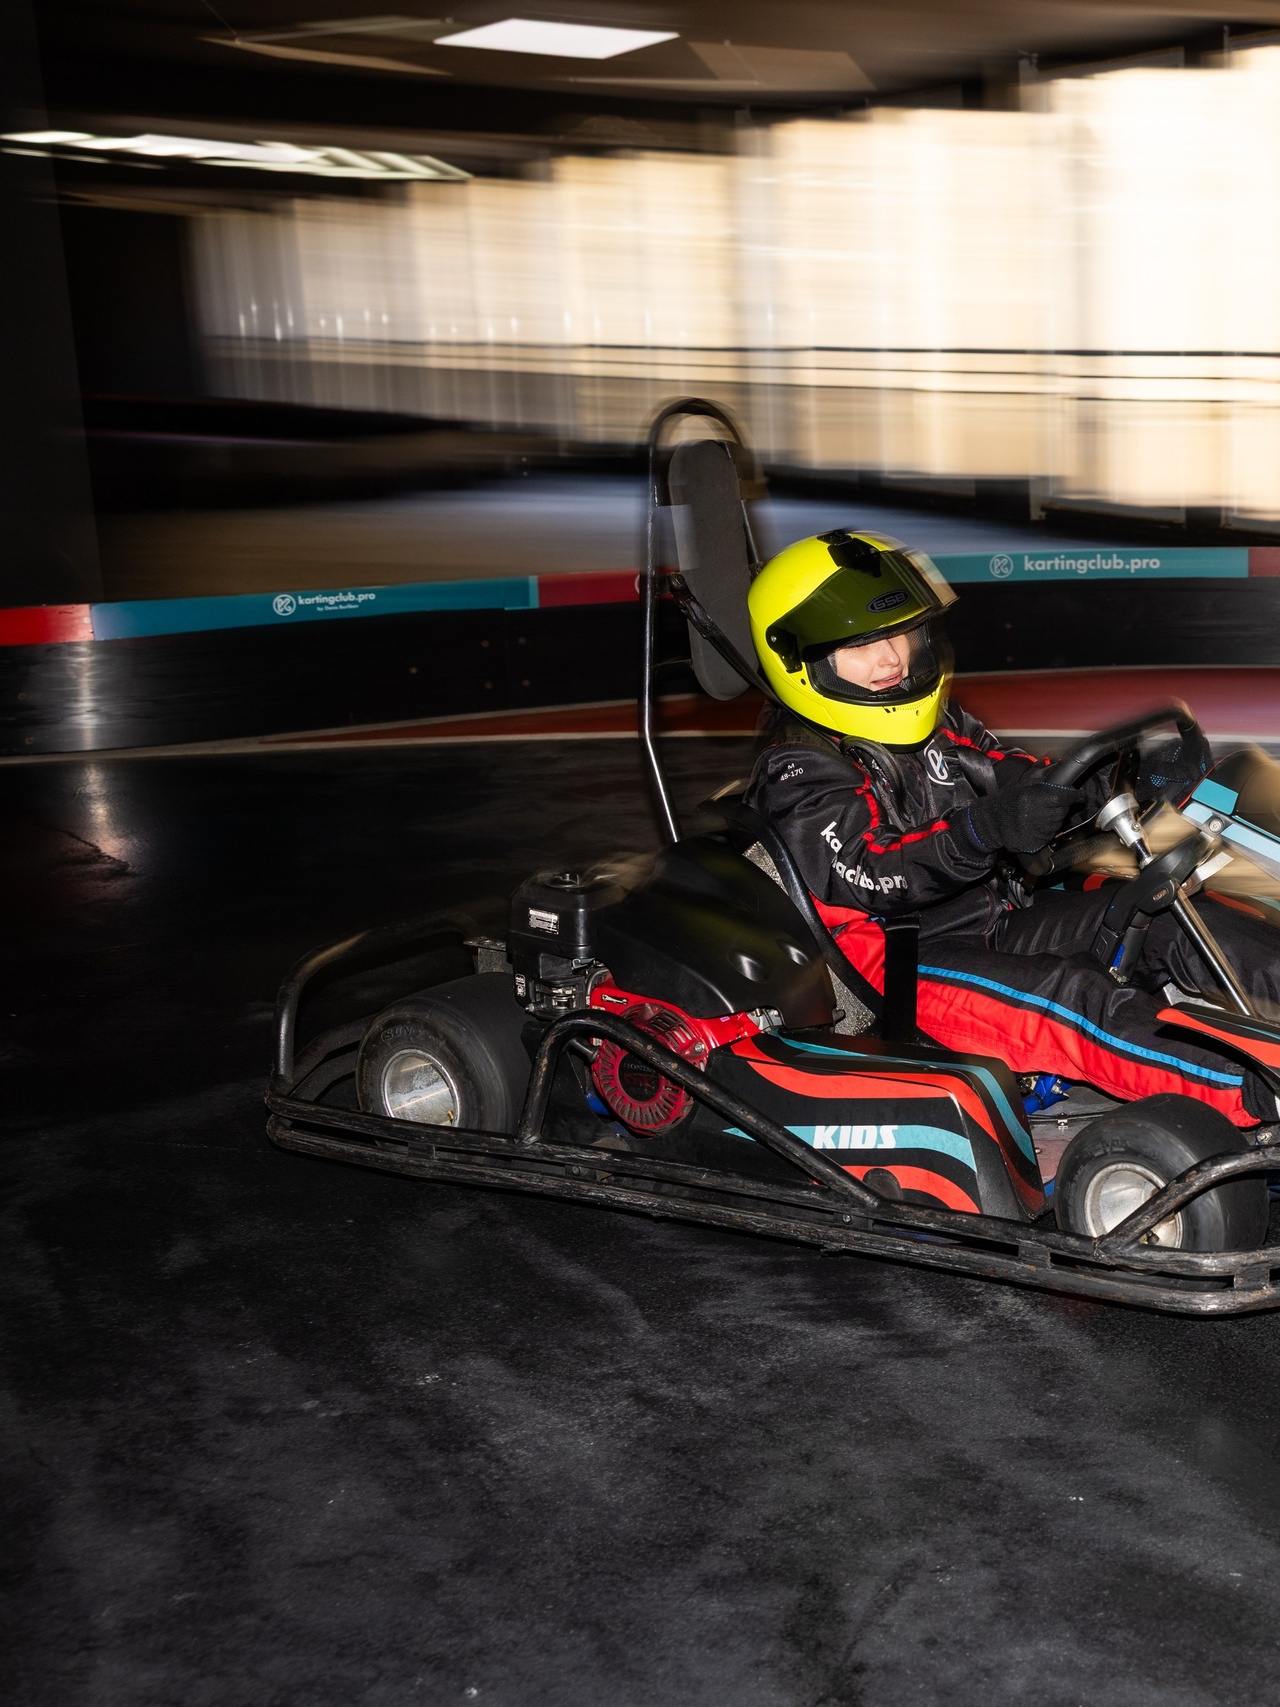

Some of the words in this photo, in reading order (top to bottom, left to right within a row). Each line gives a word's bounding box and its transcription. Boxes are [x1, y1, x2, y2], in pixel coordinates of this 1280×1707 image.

[1024, 554, 1161, 574] kartingclub.pro
[298, 592, 376, 605] kartingclub.pro
[780, 767, 804, 781] 48-170
[812, 1125, 899, 1149] KIDS
